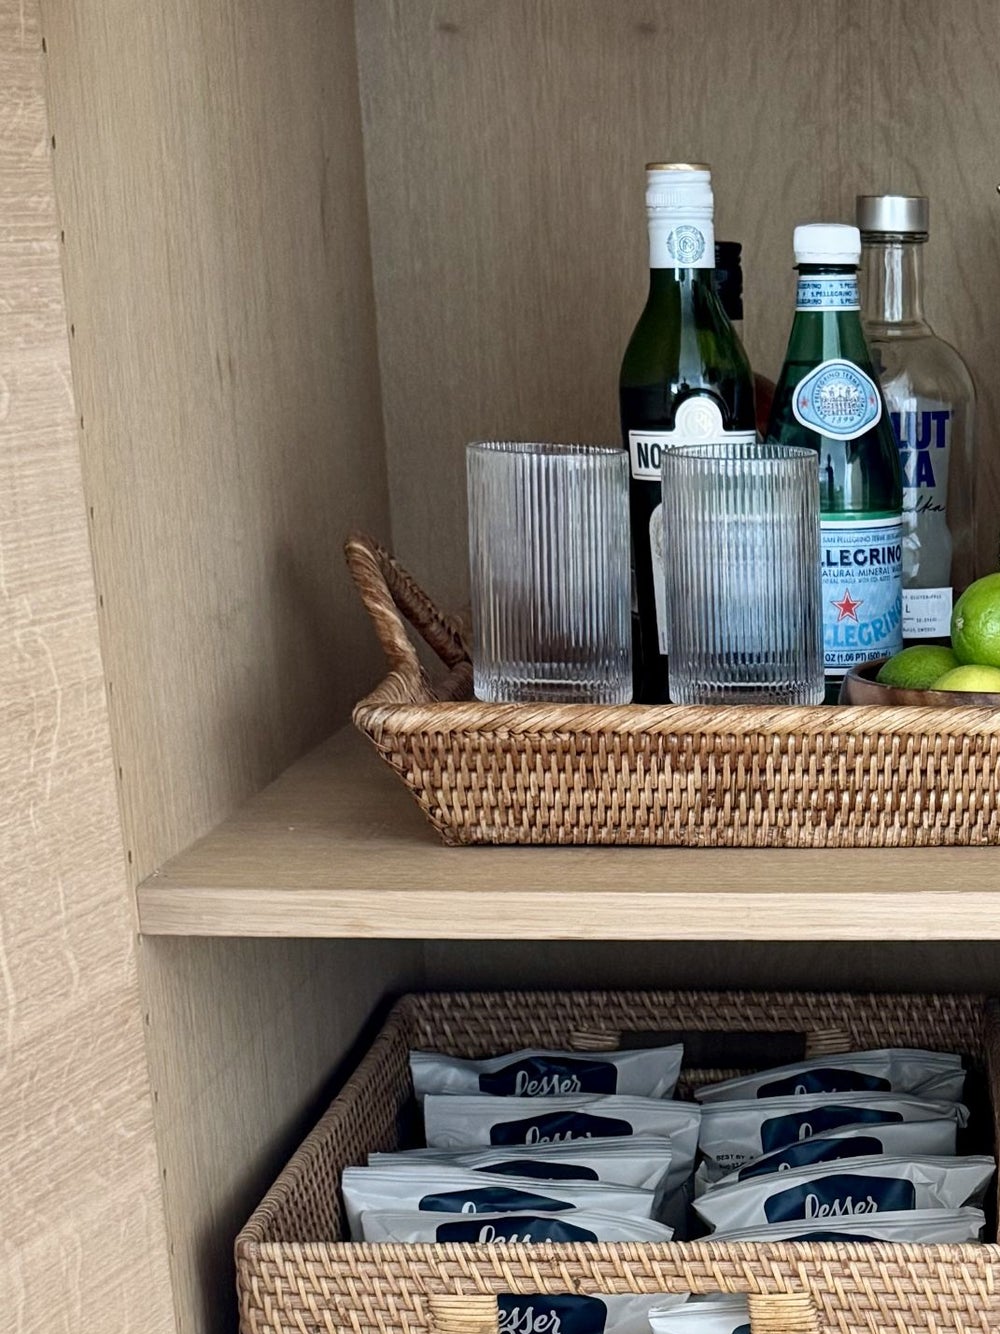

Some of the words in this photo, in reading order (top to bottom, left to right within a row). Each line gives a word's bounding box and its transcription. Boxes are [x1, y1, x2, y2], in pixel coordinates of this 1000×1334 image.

[890, 410, 950, 450] LUT
[821, 544, 901, 567] LEGRINO
[822, 568, 855, 578] ATURAL
[498, 1306, 561, 1334] esser
